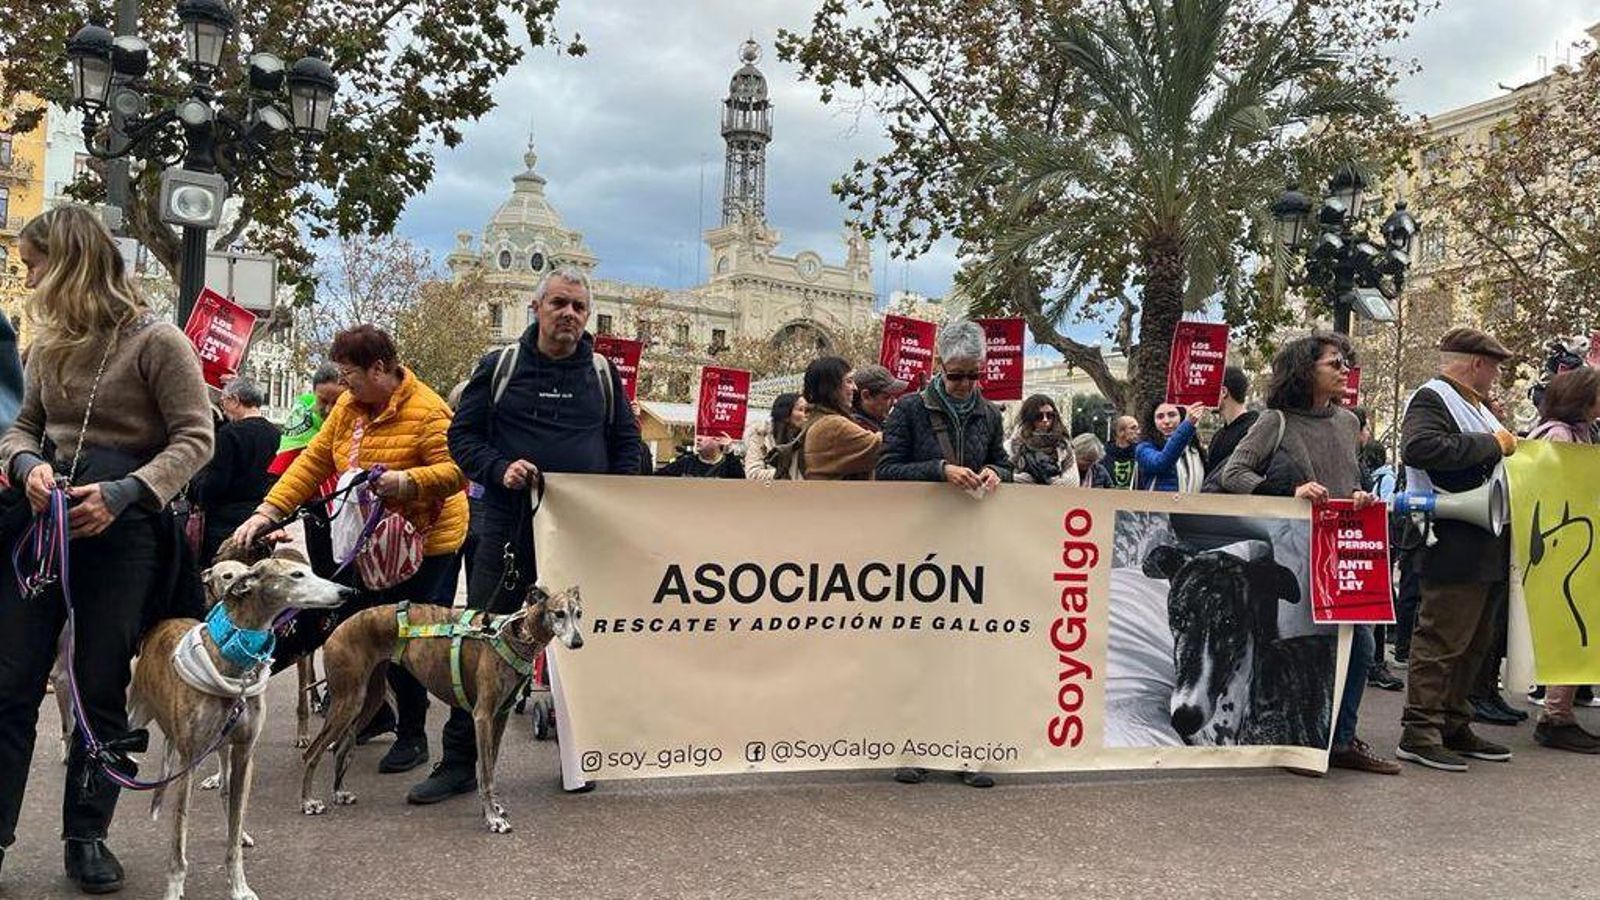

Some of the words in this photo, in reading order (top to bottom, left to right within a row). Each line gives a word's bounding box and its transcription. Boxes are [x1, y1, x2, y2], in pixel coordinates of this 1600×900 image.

[901, 337, 919, 346] LOS
[987, 337, 1007, 345] LOS
[1191, 342, 1210, 350] LOS
[1190, 350, 1223, 359] PERROS
[899, 358, 924, 368] ANTE
[987, 358, 1013, 366] ANTE
[987, 365, 1001, 373] LA
[1189, 363, 1215, 372] ANTE
[897, 372, 915, 380] LEY
[1188, 378, 1207, 386] LEY
[717, 384, 735, 392] LOS
[715, 402, 738, 411] ANTE
[1337, 529, 1364, 539] LOS
[1337, 541, 1384, 550] PERROS
[1338, 560, 1374, 570] ANTE
[652, 553, 985, 605] ASOCIACIÓN
[1338, 570, 1357, 580] LA
[1339, 580, 1364, 590] LEY
[593, 618, 718, 633] RESCATE
[728, 618, 742, 632] Y
[750, 612, 883, 632] ADOPCIÓN
[891, 616, 922, 630] DE
[931, 617, 1032, 634] GALGOS
[1047, 508, 1100, 748] SoyGalgo
[770, 738, 896, 763] @SoyGalgo
[900, 739, 1019, 761] Asociación
[607, 744, 723, 771] soy_galgo
